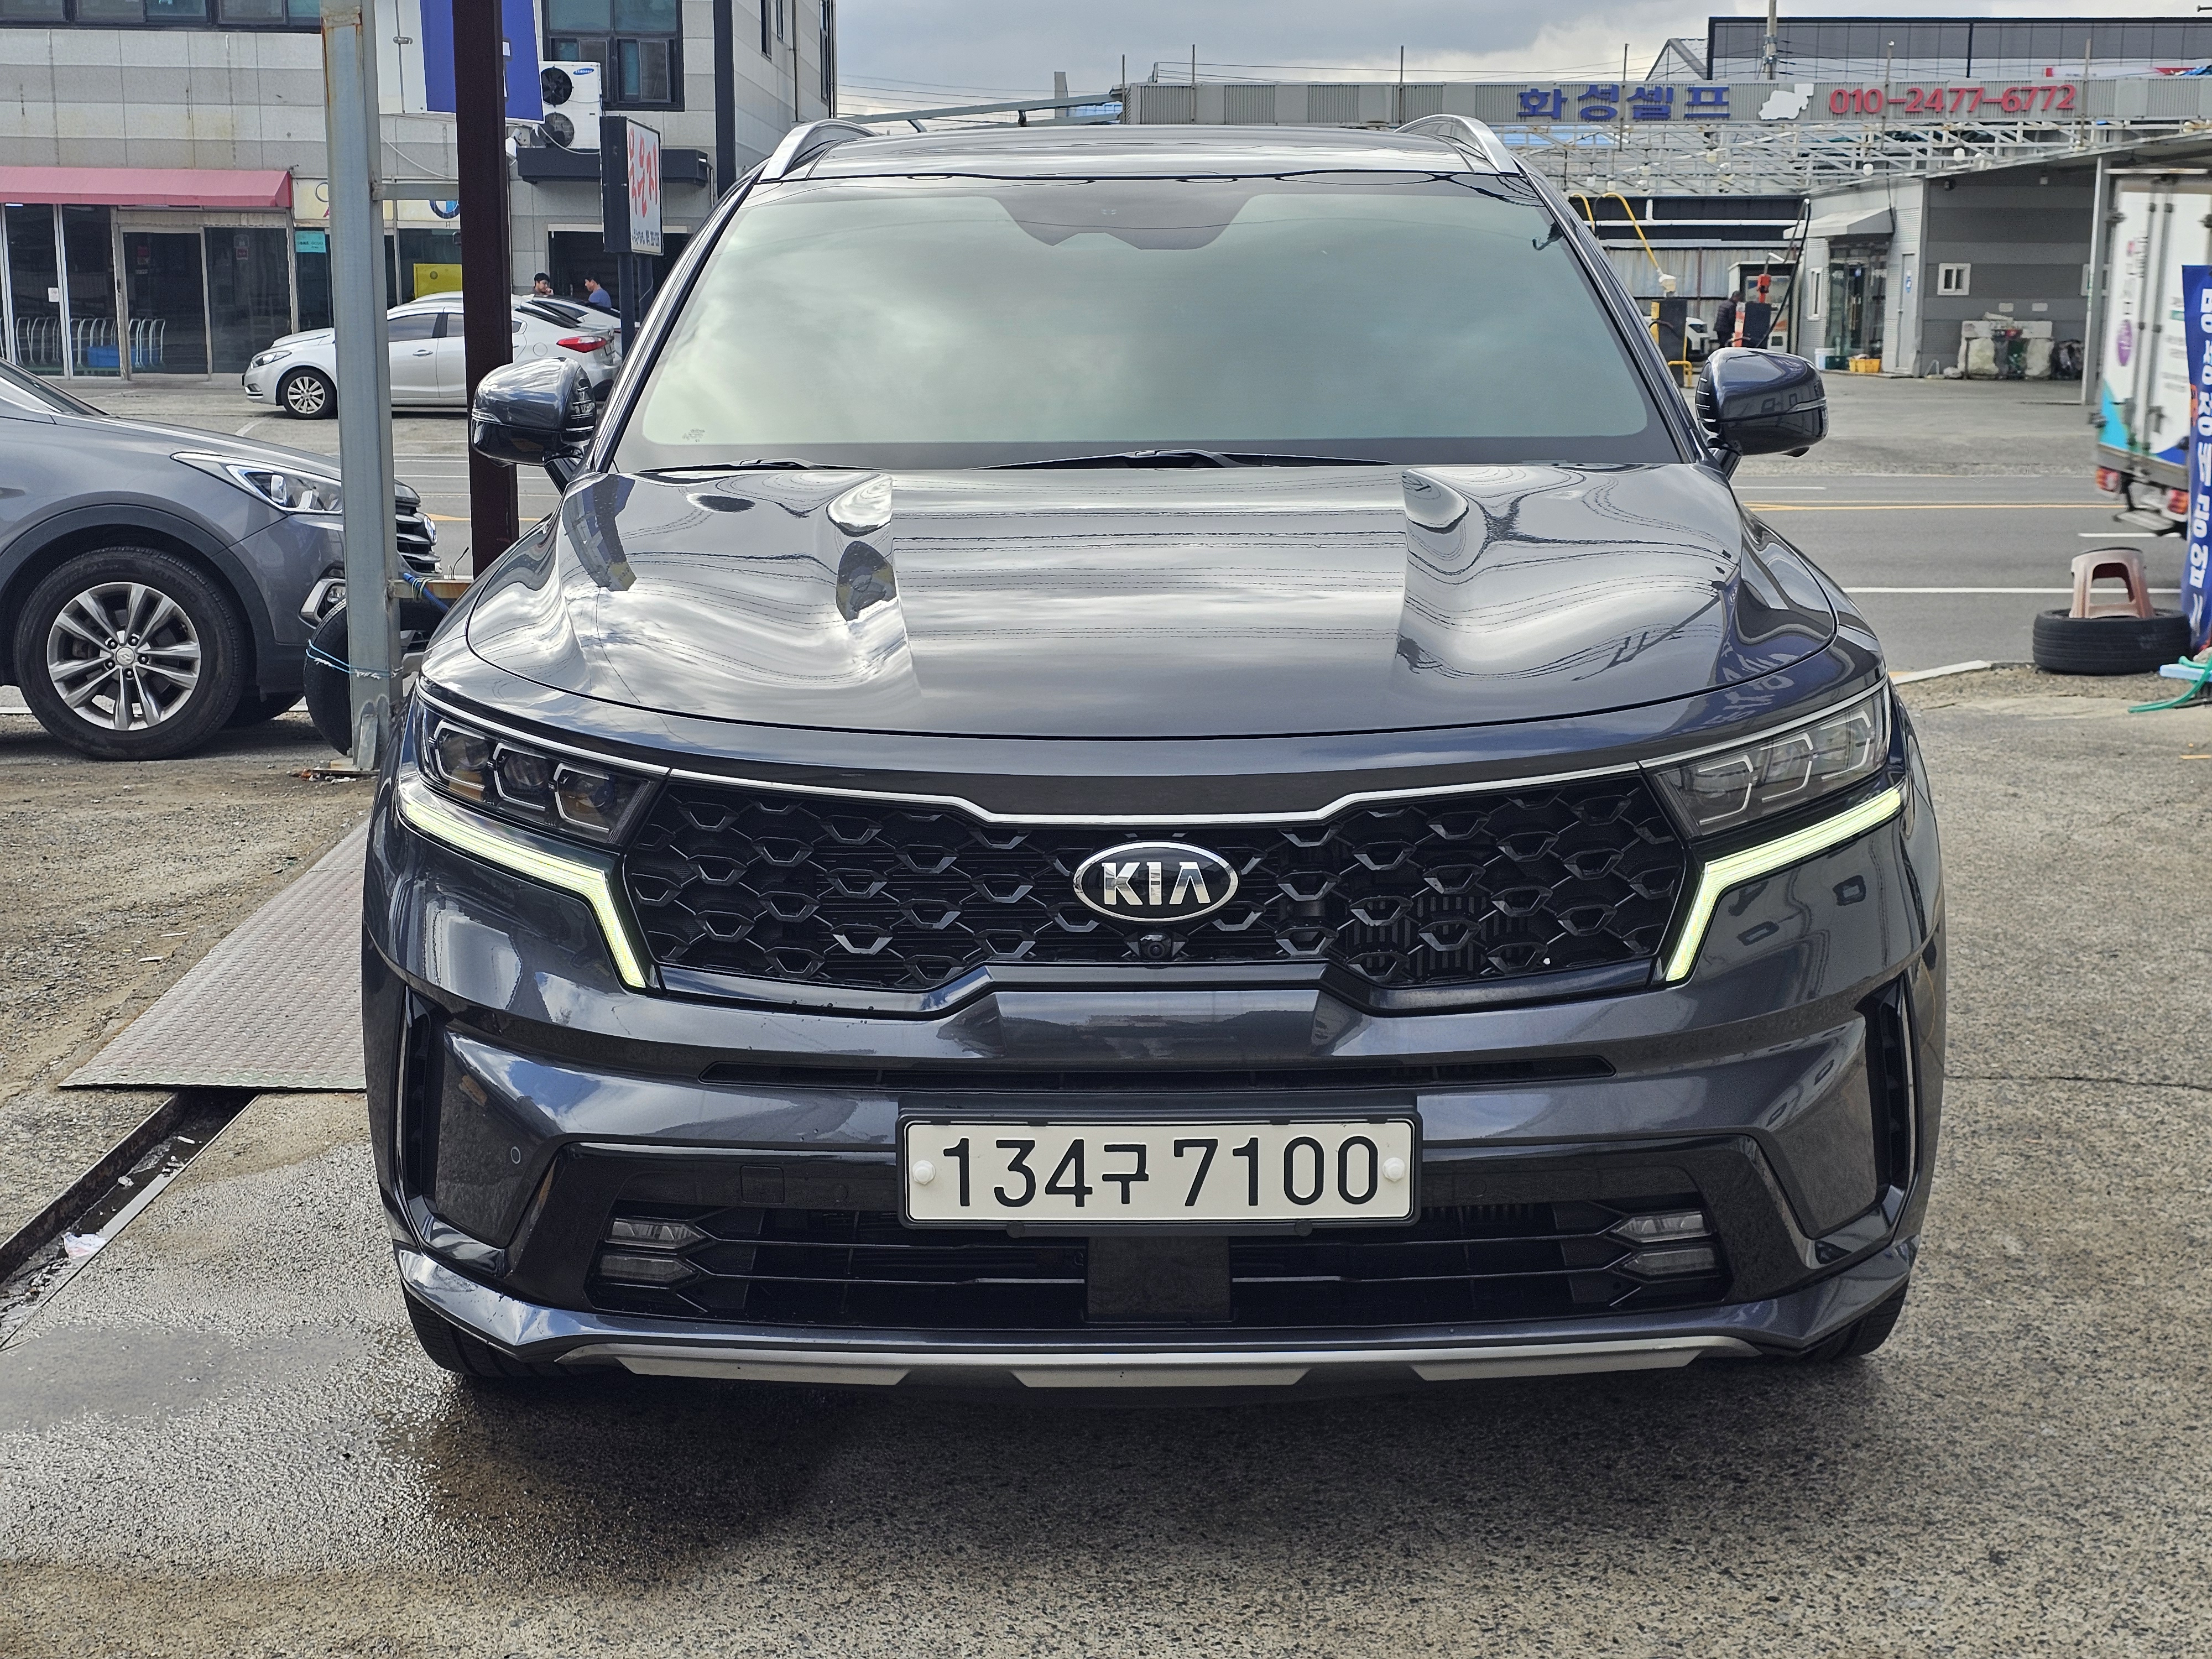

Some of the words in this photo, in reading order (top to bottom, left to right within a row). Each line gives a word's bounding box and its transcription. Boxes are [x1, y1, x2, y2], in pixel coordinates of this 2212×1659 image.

[1519, 84, 1731, 120] 화성셀프
[1829, 84, 2077, 114] 010-2477-6772
[1102, 862, 1211, 905] KIA
[942, 1138, 1149, 1208] 134구
[1173, 1135, 1379, 1207] 7100
